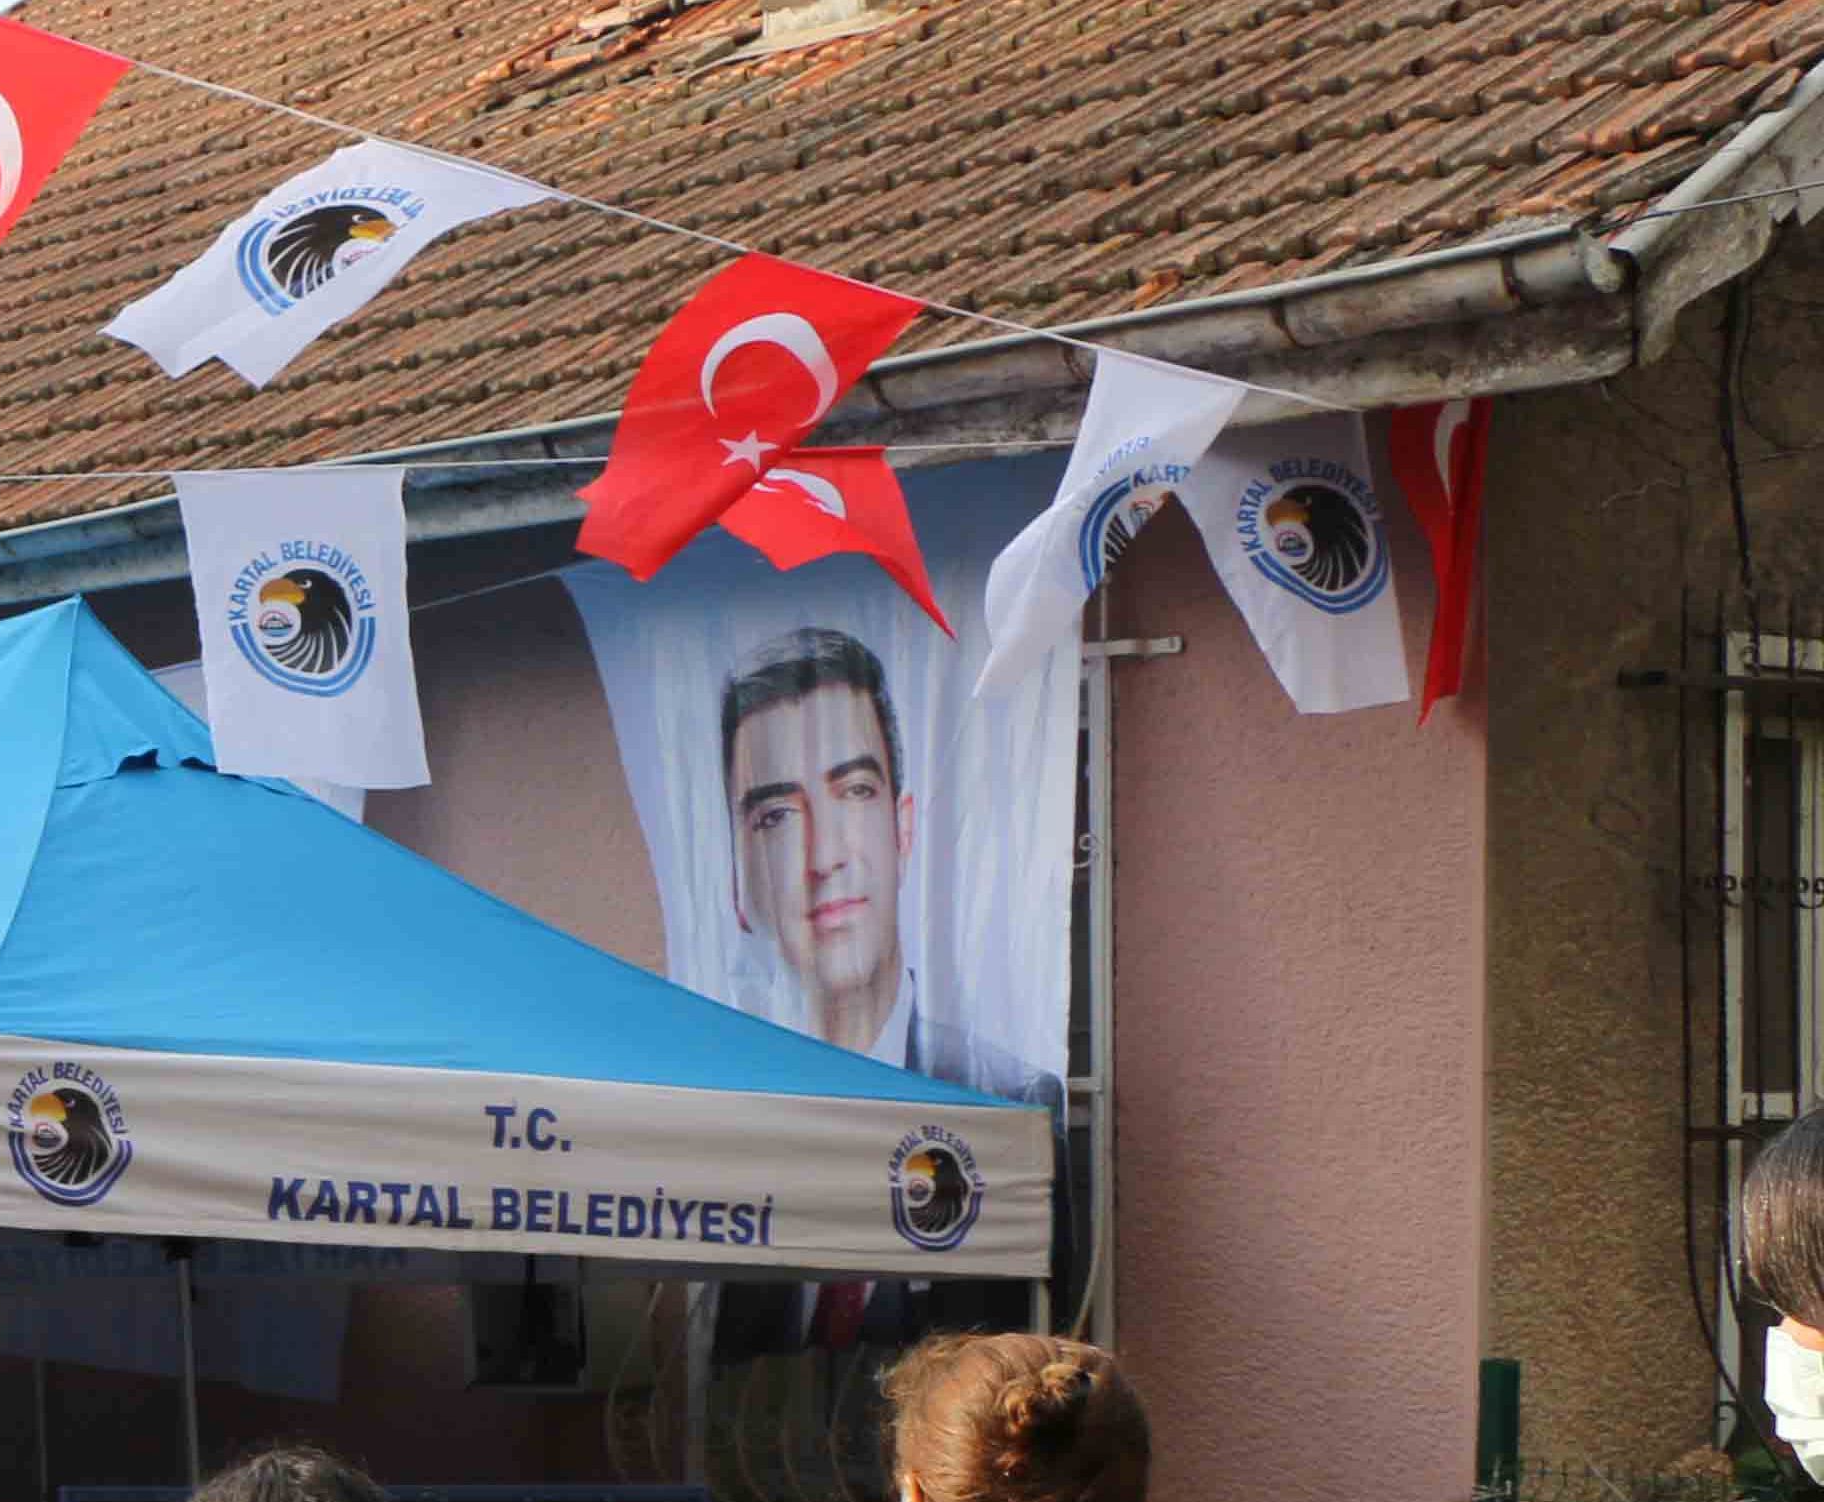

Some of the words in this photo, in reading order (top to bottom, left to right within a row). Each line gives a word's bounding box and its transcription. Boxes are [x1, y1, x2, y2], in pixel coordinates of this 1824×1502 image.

[228, 551, 278, 621] KARTAL
[7, 1066, 49, 1129] KARTAL
[485, 1104, 572, 1152] T.C.
[267, 1176, 473, 1230] KARTAL
[490, 1186, 775, 1246] BELEDİYESİ
